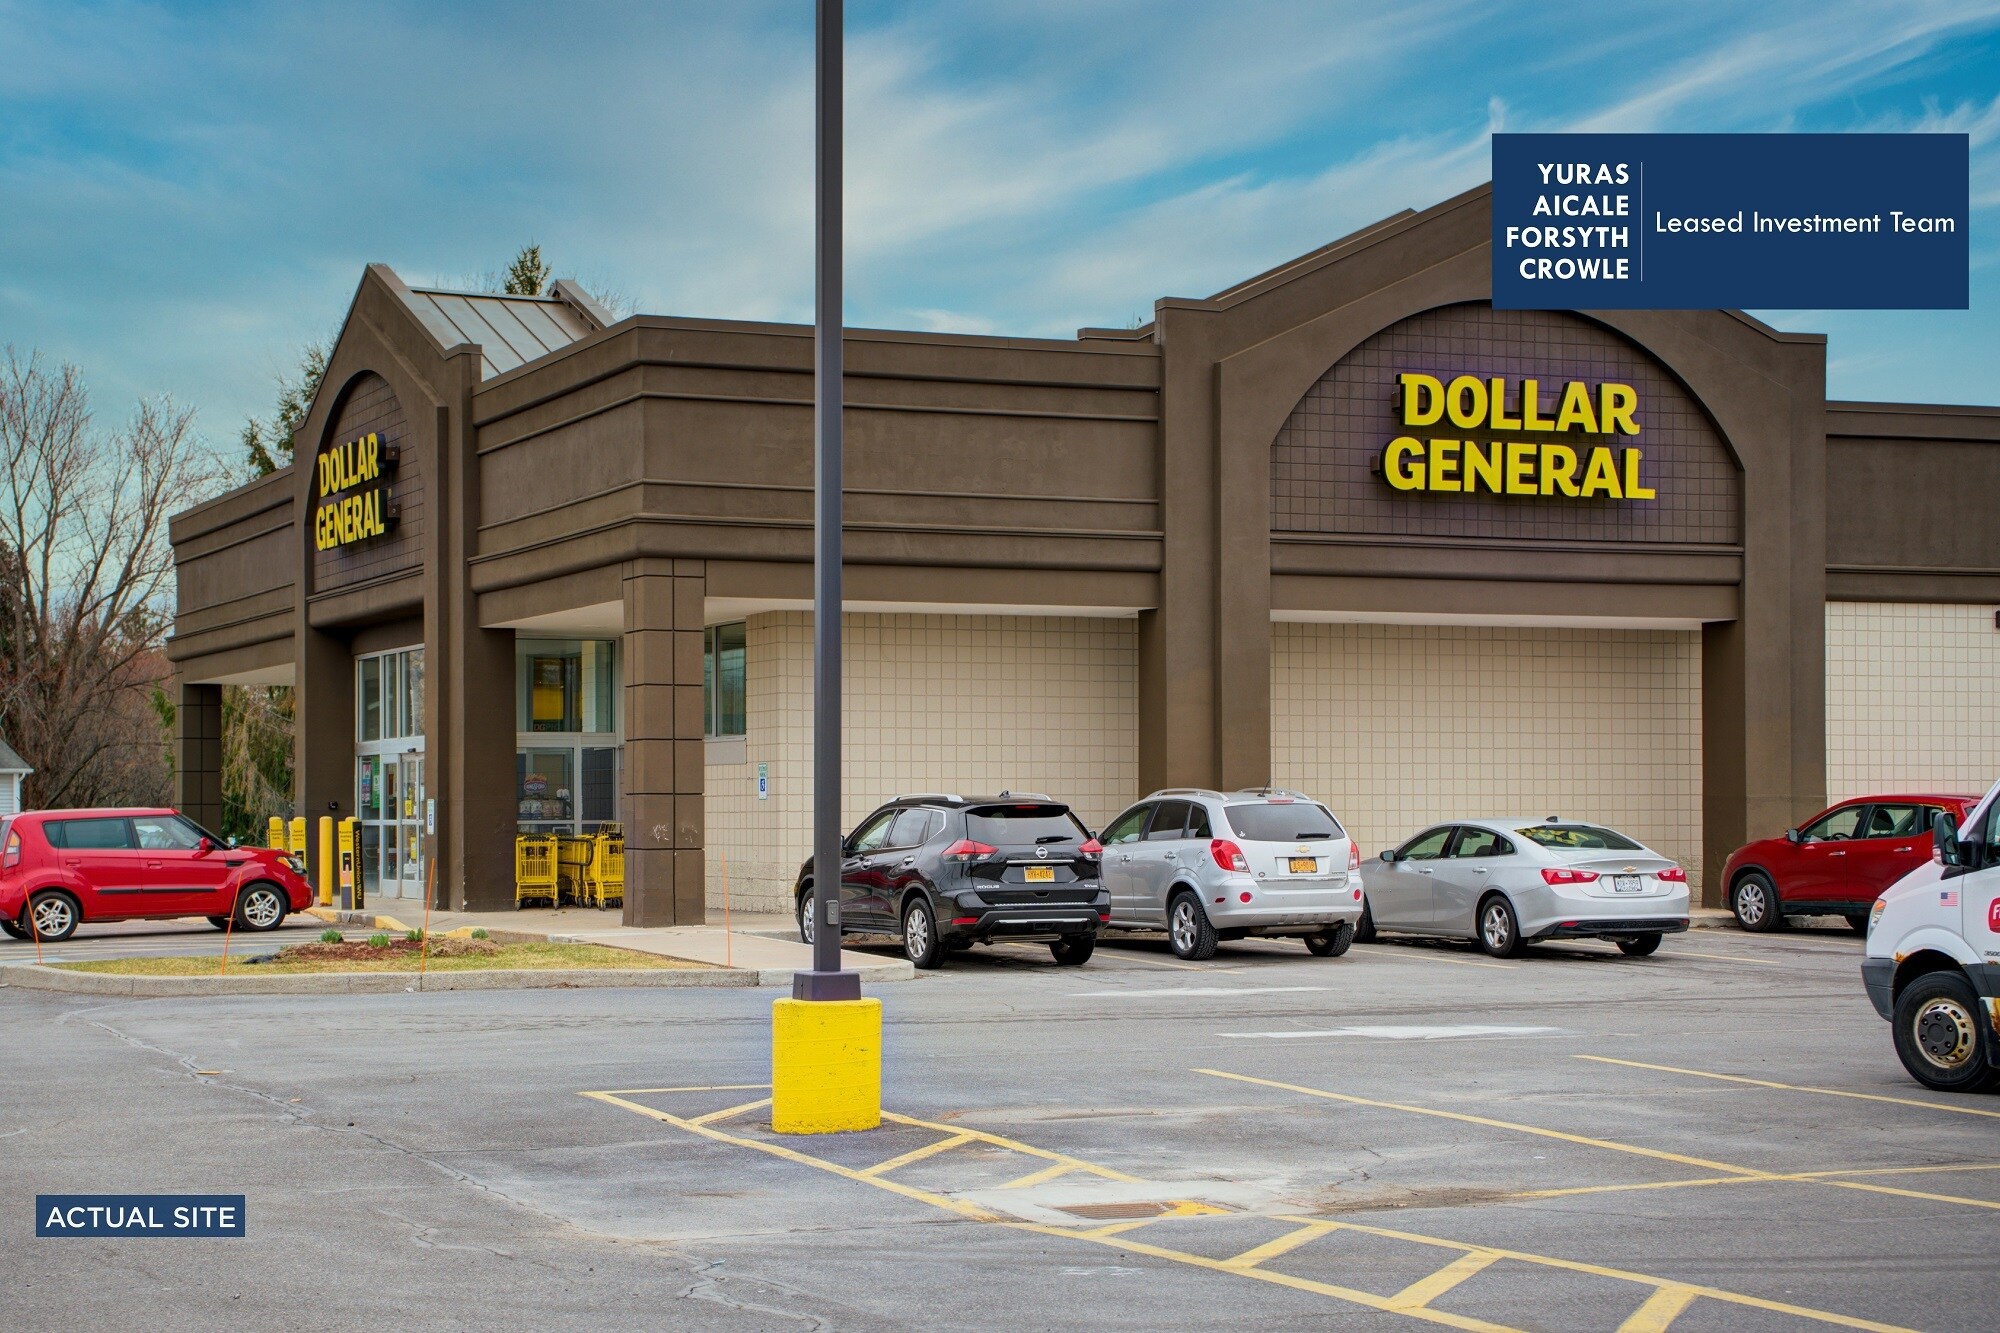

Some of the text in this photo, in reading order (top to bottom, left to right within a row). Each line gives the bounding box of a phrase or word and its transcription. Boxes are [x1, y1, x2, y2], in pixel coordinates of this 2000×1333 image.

[1400, 373, 1641, 435] DOLLAR
[318, 432, 379, 497] DOLLAR
[1384, 436, 1656, 500] GENERAL
[315, 489, 385, 551] GENERAL
